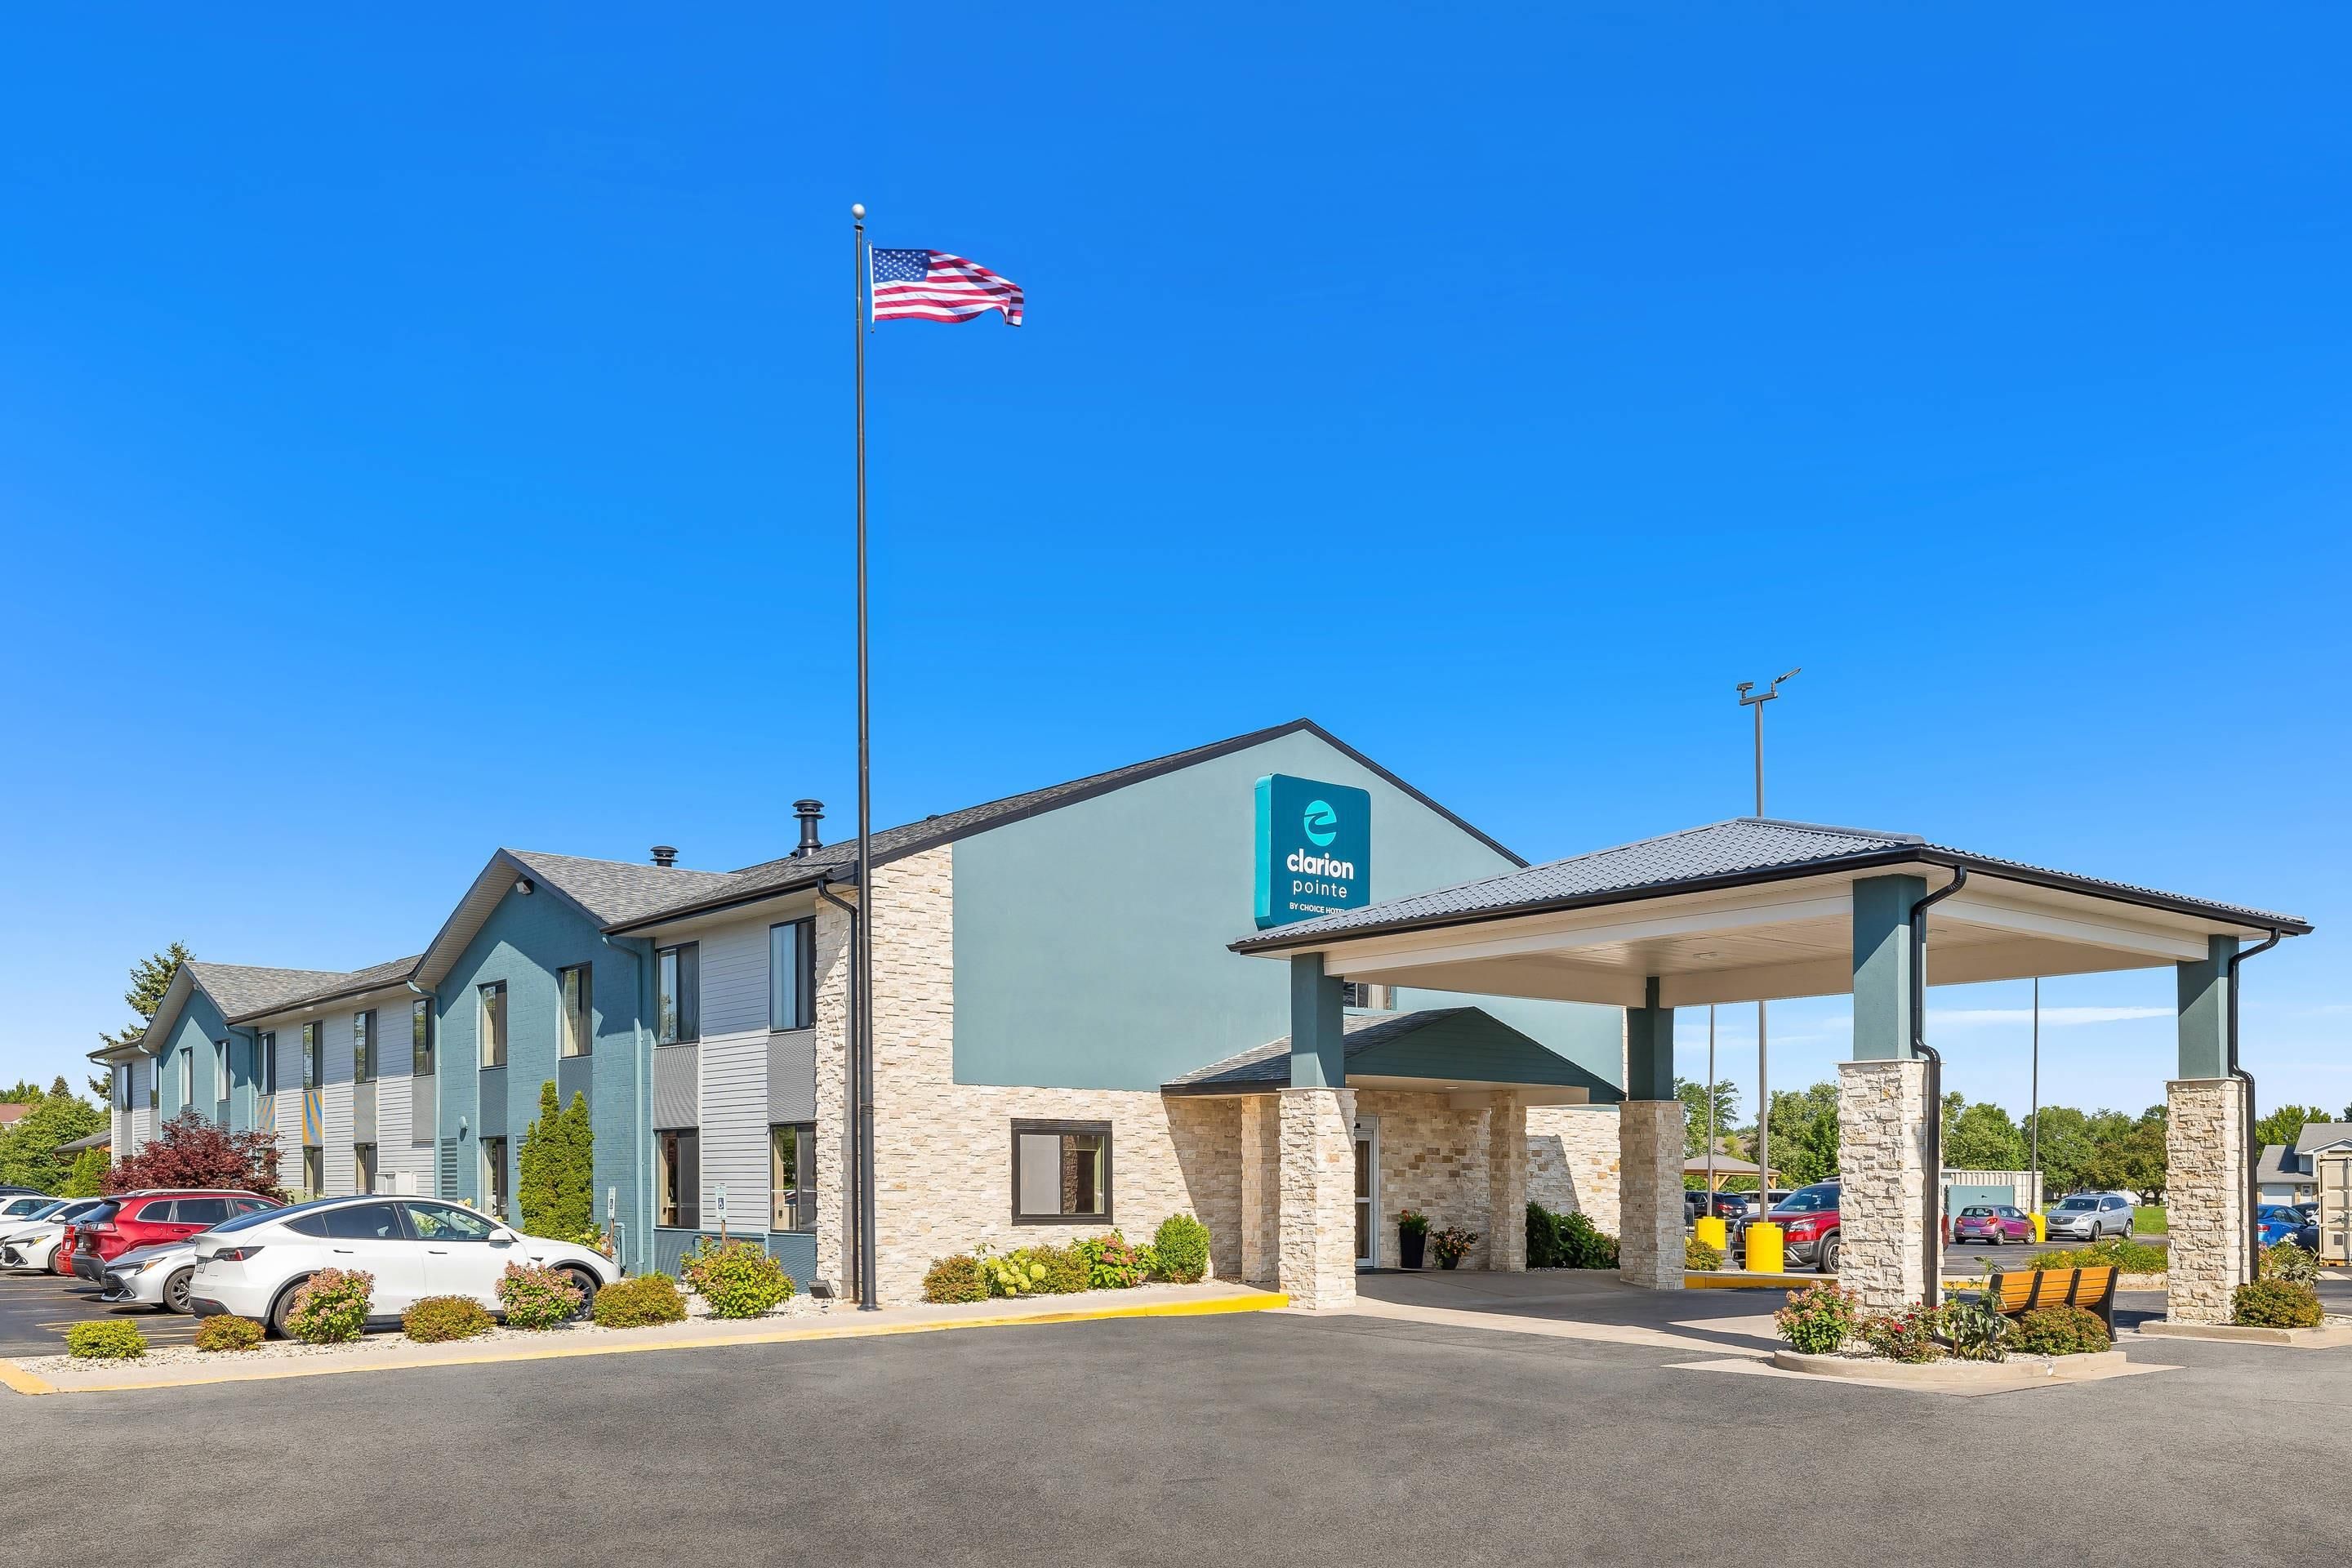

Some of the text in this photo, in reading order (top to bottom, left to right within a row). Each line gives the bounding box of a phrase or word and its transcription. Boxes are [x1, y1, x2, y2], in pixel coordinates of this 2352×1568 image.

[1287, 849, 1354, 880] clarion
[1293, 880, 1348, 898] pointe
[1299, 903, 1325, 913] CHOICE
